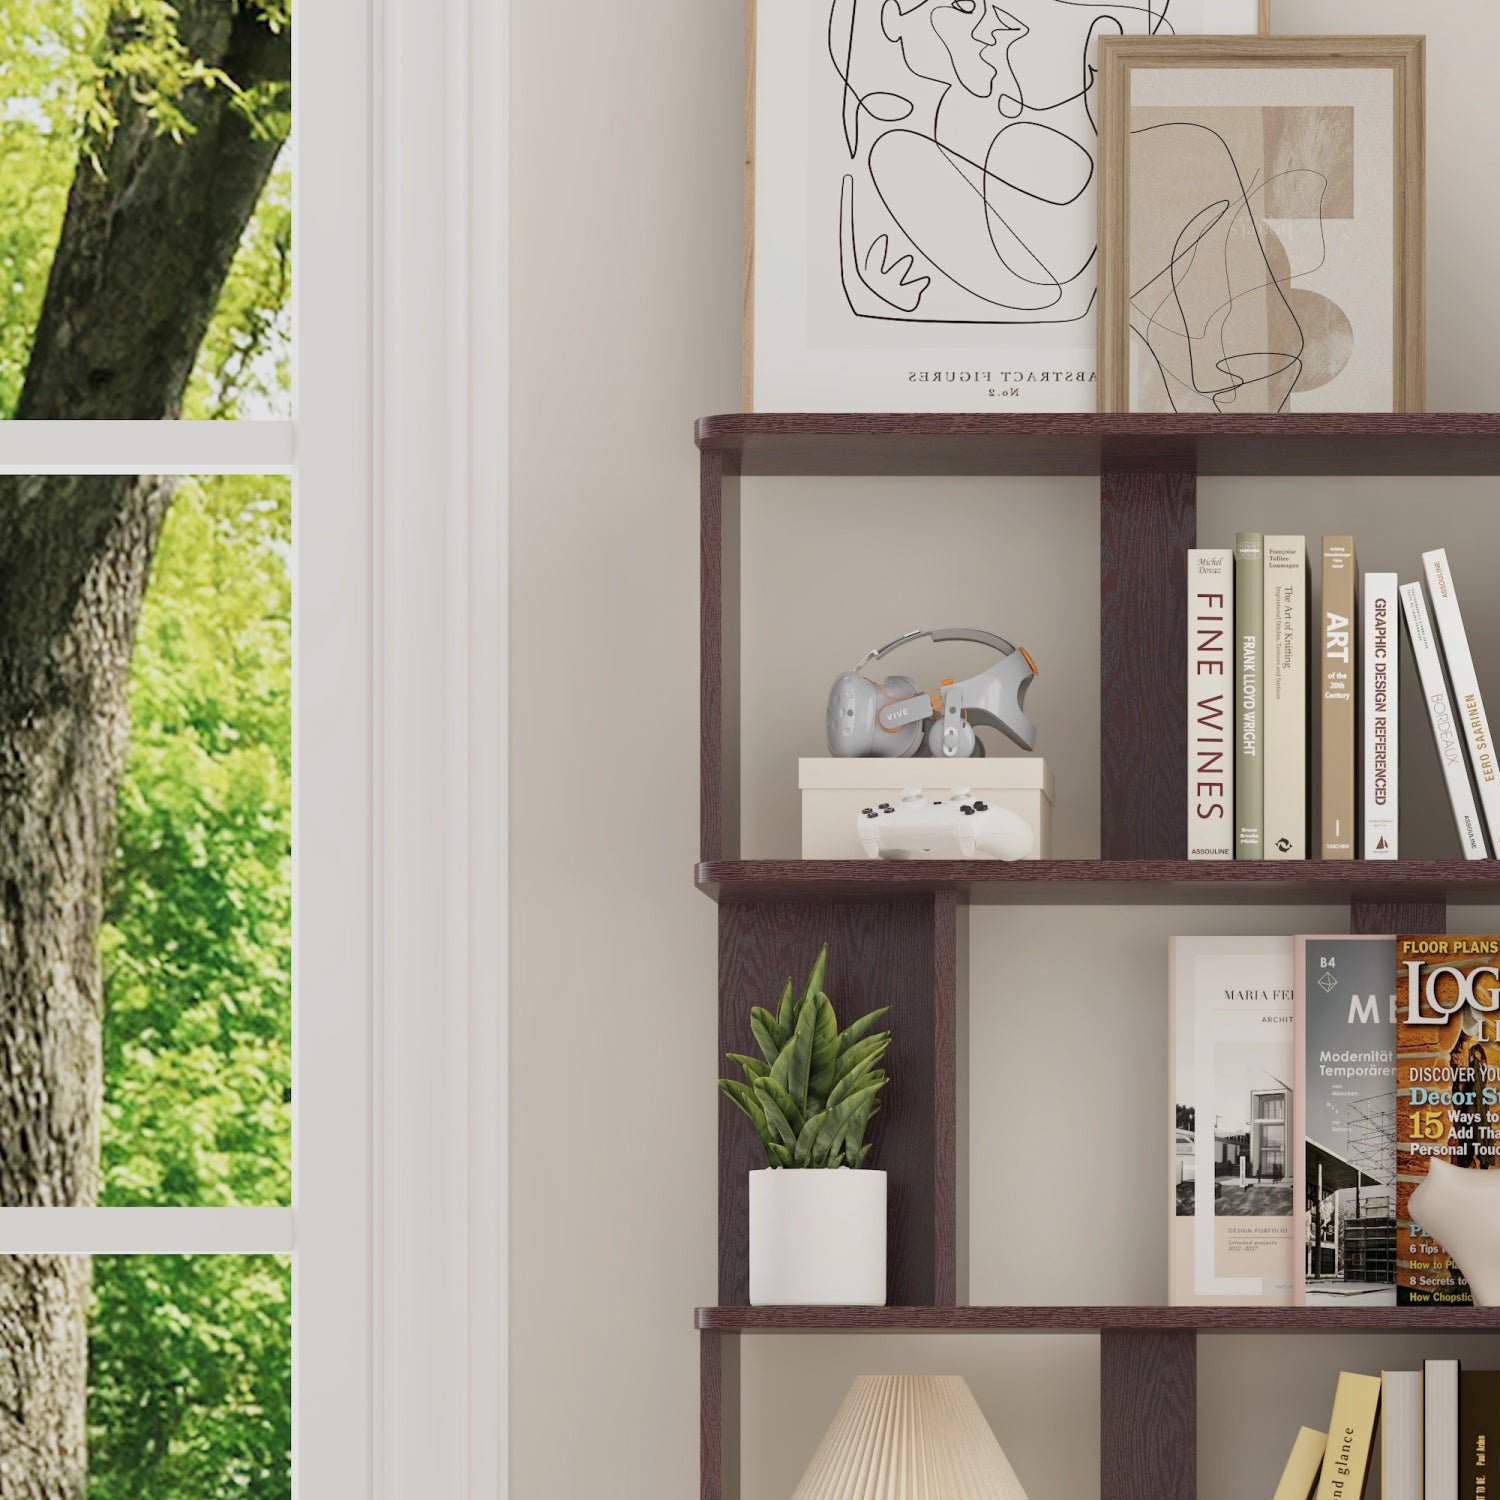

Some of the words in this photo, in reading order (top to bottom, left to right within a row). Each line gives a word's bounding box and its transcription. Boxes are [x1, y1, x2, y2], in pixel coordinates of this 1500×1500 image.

[1284, 585, 1294, 603] The
[1284, 605, 1294, 620] Art
[1374, 597, 1387, 659] GRAPHIC
[1196, 593, 1224, 676] FINE
[1282, 631, 1294, 669] Knitting
[1325, 612, 1349, 664] ART
[1242, 635, 1256, 673] FRANK
[1242, 675, 1256, 711] LLOYD
[1327, 672, 1337, 680] of
[1337, 672, 1348, 680] the
[1329, 682, 1346, 690] 20th
[1374, 662, 1387, 713] DESIGN
[886, 707, 909, 721] VIVE
[1324, 691, 1351, 701] Century
[1242, 712, 1256, 757] WRIGHT
[1430, 693, 1459, 767] BORDEAUX
[1464, 693, 1488, 751] SAARINEN
[1196, 694, 1224, 820] WINES
[1374, 715, 1387, 806] REFERENCED
[1479, 751, 1495, 783] EERO
[1463, 815, 1478, 850] ASSOULINE
[1319, 957, 1337, 968] B4
[1402, 941, 1448, 954] FLOOR
[1452, 941, 1499, 954] PLANS
[1224, 989, 1268, 1001] MARIA
[1319, 1050, 1394, 1062] Modernität
[1334, 1427, 1355, 1477] glance
